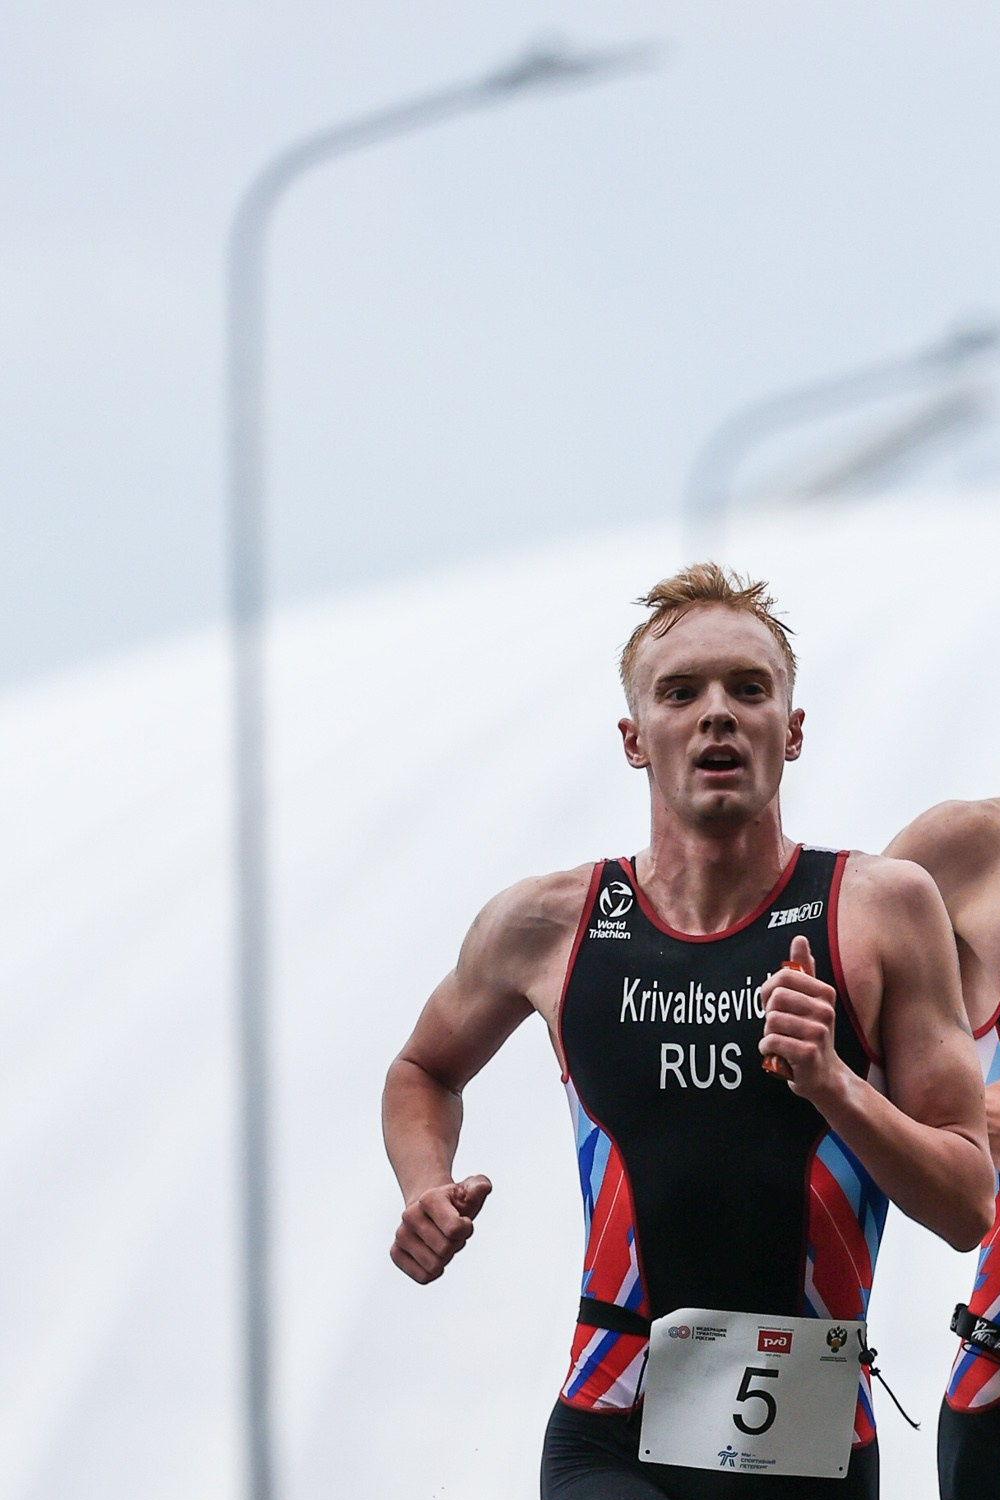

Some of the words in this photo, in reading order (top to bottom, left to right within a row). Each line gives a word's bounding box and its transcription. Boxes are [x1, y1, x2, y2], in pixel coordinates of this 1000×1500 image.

[589, 929, 631, 940] Triathlon
[597, 919, 627, 930] World
[619, 972, 772, 1025] Krivaltsevic
[659, 1042, 743, 1090] RUS
[732, 1366, 780, 1436] 5
